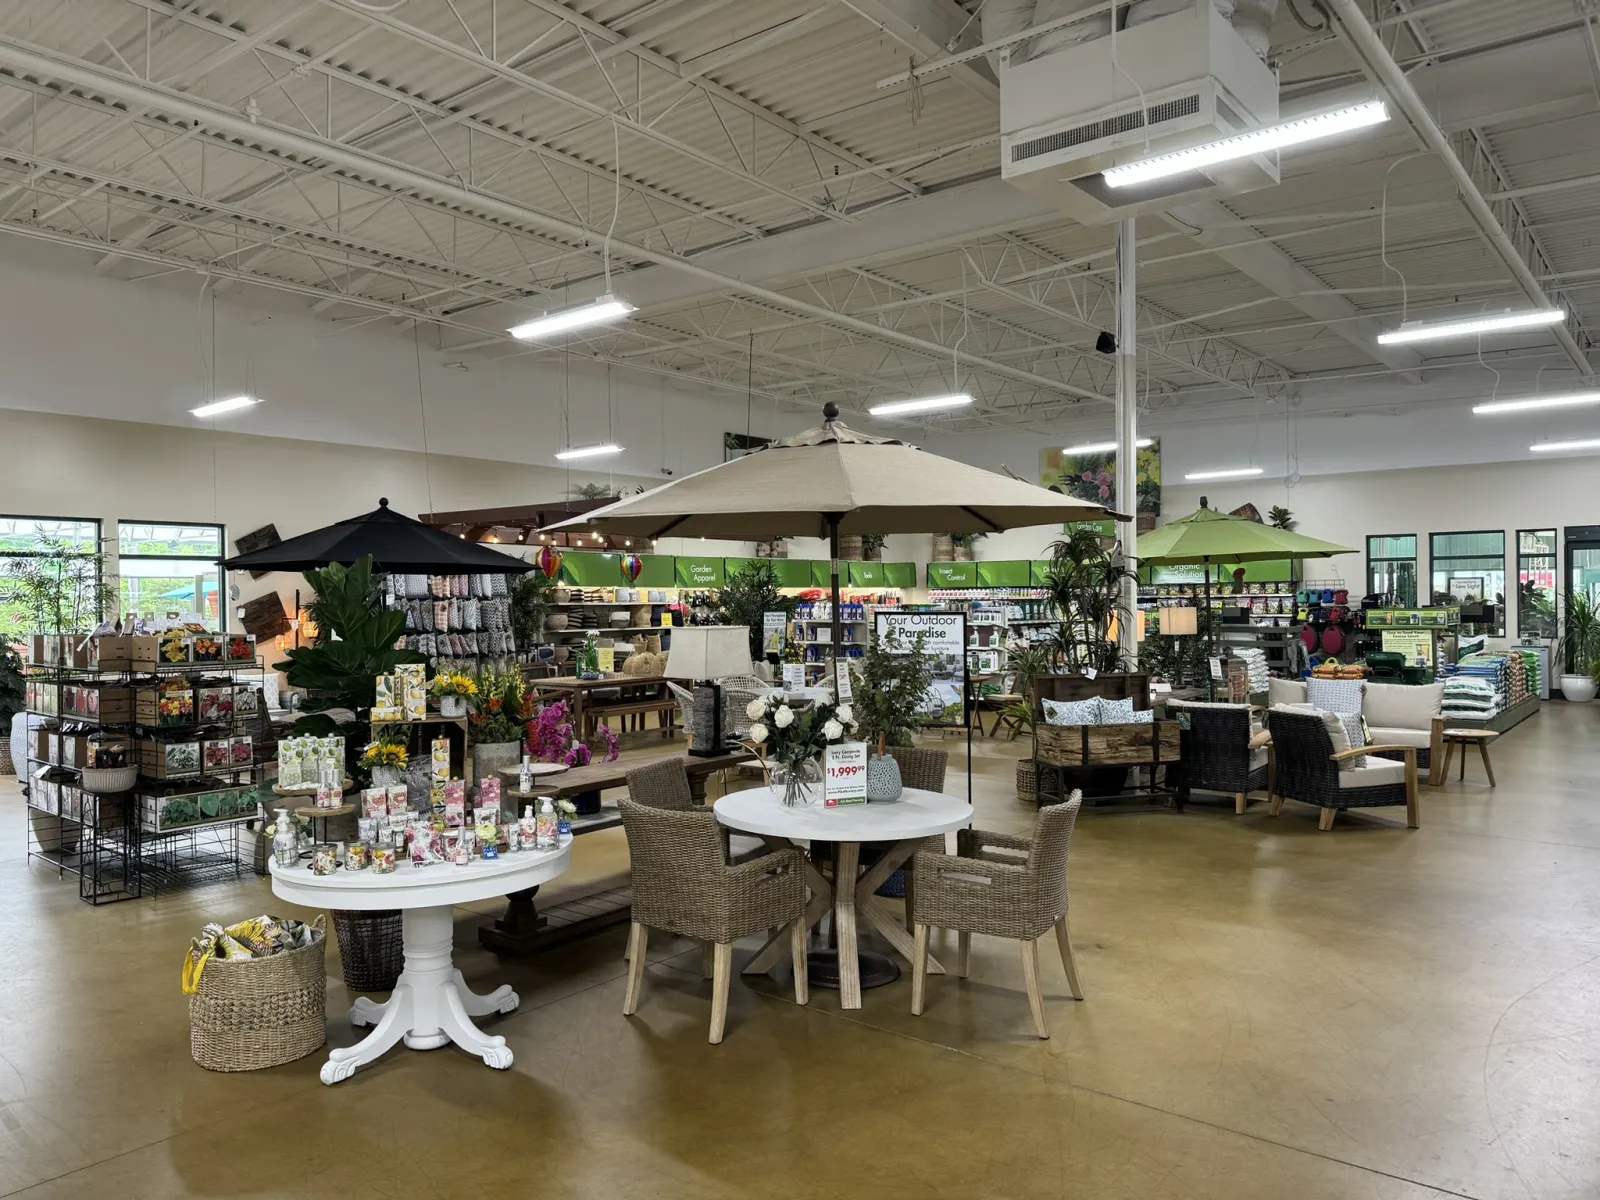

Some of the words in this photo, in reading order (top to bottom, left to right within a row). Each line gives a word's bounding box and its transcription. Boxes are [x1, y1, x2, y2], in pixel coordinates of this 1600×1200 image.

[1076, 521, 1091, 530] Garden
[1092, 521, 1103, 532] Care
[690, 564, 712, 573] Garden
[694, 573, 716, 583] Apparel
[863, 571, 873, 579] Tools
[884, 614, 907, 625] Your
[911, 613, 957, 625] Outdoor
[899, 626, 946, 638] Pardise
